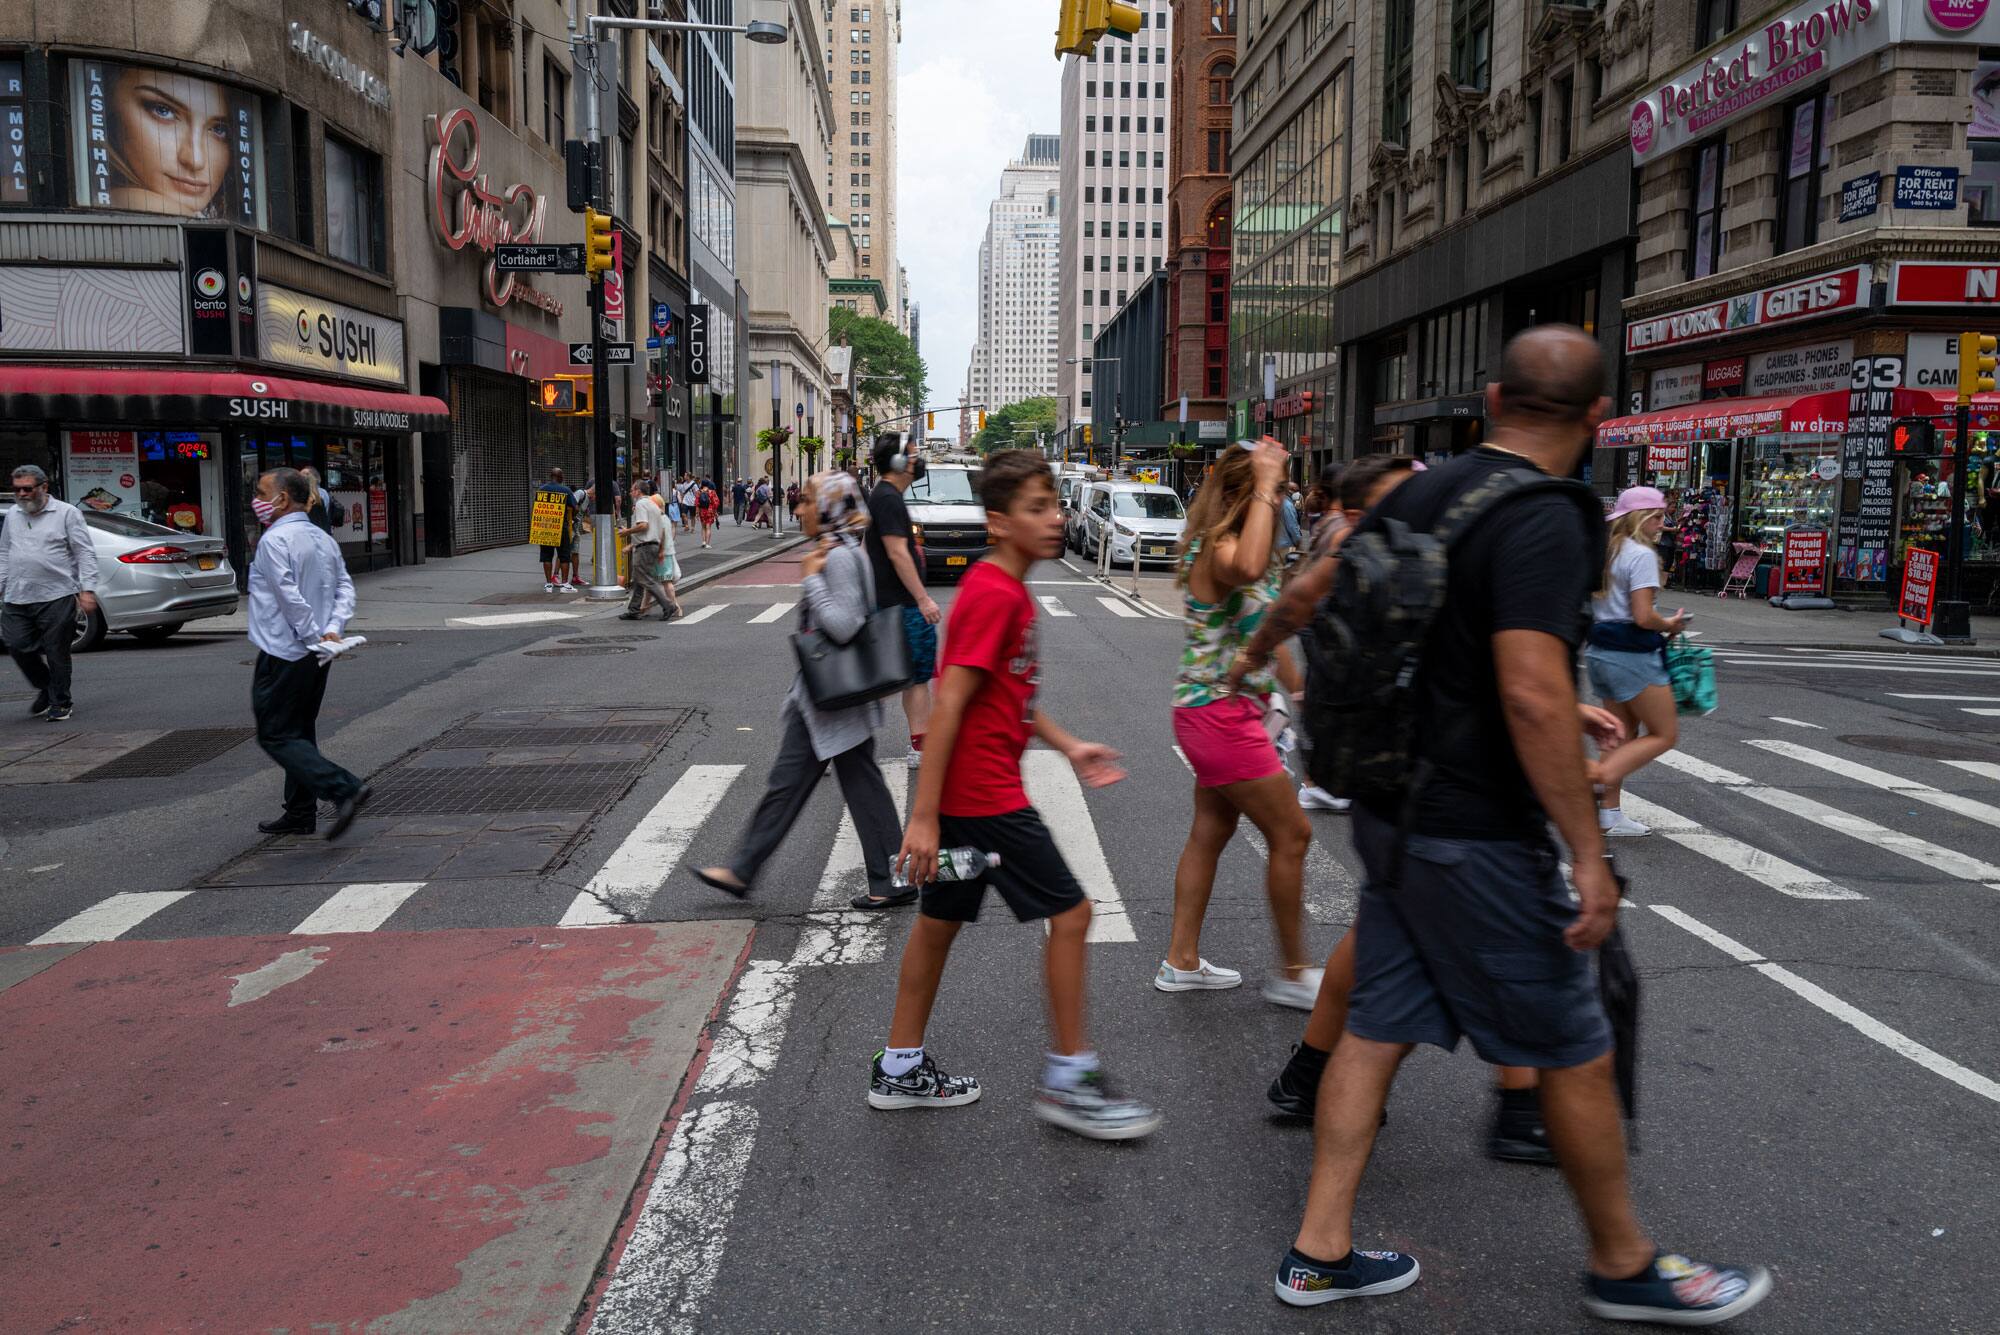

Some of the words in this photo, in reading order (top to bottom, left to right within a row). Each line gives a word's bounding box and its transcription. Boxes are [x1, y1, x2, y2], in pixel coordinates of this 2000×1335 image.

[1659, 43, 1752, 128] Perfect
[1765, 0, 1872, 72] Brows
[1696, 86, 1761, 128] THREADING
[1763, 60, 1808, 93] SALON
[90, 69, 105, 142] LASER
[9, 79, 24, 190] RMOVAL
[239, 109, 251, 214] REMOVAL
[94, 148, 110, 205] HAIR
[1914, 169, 1942, 177] Office
[1852, 178, 1869, 189] Office
[1899, 178, 1921, 189] FOR
[1924, 178, 1954, 190] RENT
[1843, 190, 1857, 203] FOR
[1858, 183, 1877, 199] RENT
[1898, 189, 1953, 200] 917-476-1428
[500, 254, 547, 265] Cortlandt
[194, 299, 227, 310] bento
[1766, 277, 1841, 318] GIFTS
[196, 310, 225, 318] SUSHI
[1631, 319, 1671, 348] NEW
[1669, 306, 1722, 339] YORK
[318, 313, 376, 366] SUSHI
[690, 314, 704, 375] ALDO
[1767, 353, 1798, 370] CAMERA
[1805, 347, 1839, 364] PHONES
[1707, 365, 1742, 381] LUGGAGE
[1754, 369, 1805, 387] HEADPHONES
[1811, 362, 1850, 380] SIMCARD
[1852, 360, 1870, 389] 3
[1873, 358, 1902, 388] 3
[1762, 384, 1817, 397] INTERNATIONAL
[1819, 381, 1836, 390] USE
[230, 399, 288, 418] SUSHI
[1631, 392, 1642, 414] 3
[1850, 393, 1860, 411] NY
[1871, 392, 1887, 410] NY
[354, 411, 374, 425] SUSHI
[374, 415, 380, 426] &
[380, 415, 409, 428] NOODLES
[1607, 427, 1626, 437] GLOVES
[1649, 423, 1663, 432] TOYS
[1665, 421, 1694, 430] LUGGAGE
[1703, 416, 1728, 428] SHIRTS
[1791, 421, 1807, 432] NY
[1649, 446, 1687, 459] Prepaid
[1648, 459, 1665, 470] Sim
[1666, 459, 1687, 470] Card
[537, 493, 548, 501] WE
[550, 494, 566, 503] BUY
[1862, 507, 1891, 515] PHONES
[1789, 539, 1821, 549] Prepaid
[1788, 549, 1802, 557] Sim
[1803, 549, 1821, 557] Card
[1912, 552, 1919, 561] 3
[1920, 553, 1932, 564] NY
[1795, 559, 1820, 567] Unlock
[1906, 581, 1929, 595] Prepaid
[1915, 593, 1928, 605] Card
[896, 1051, 920, 1059] FILA
